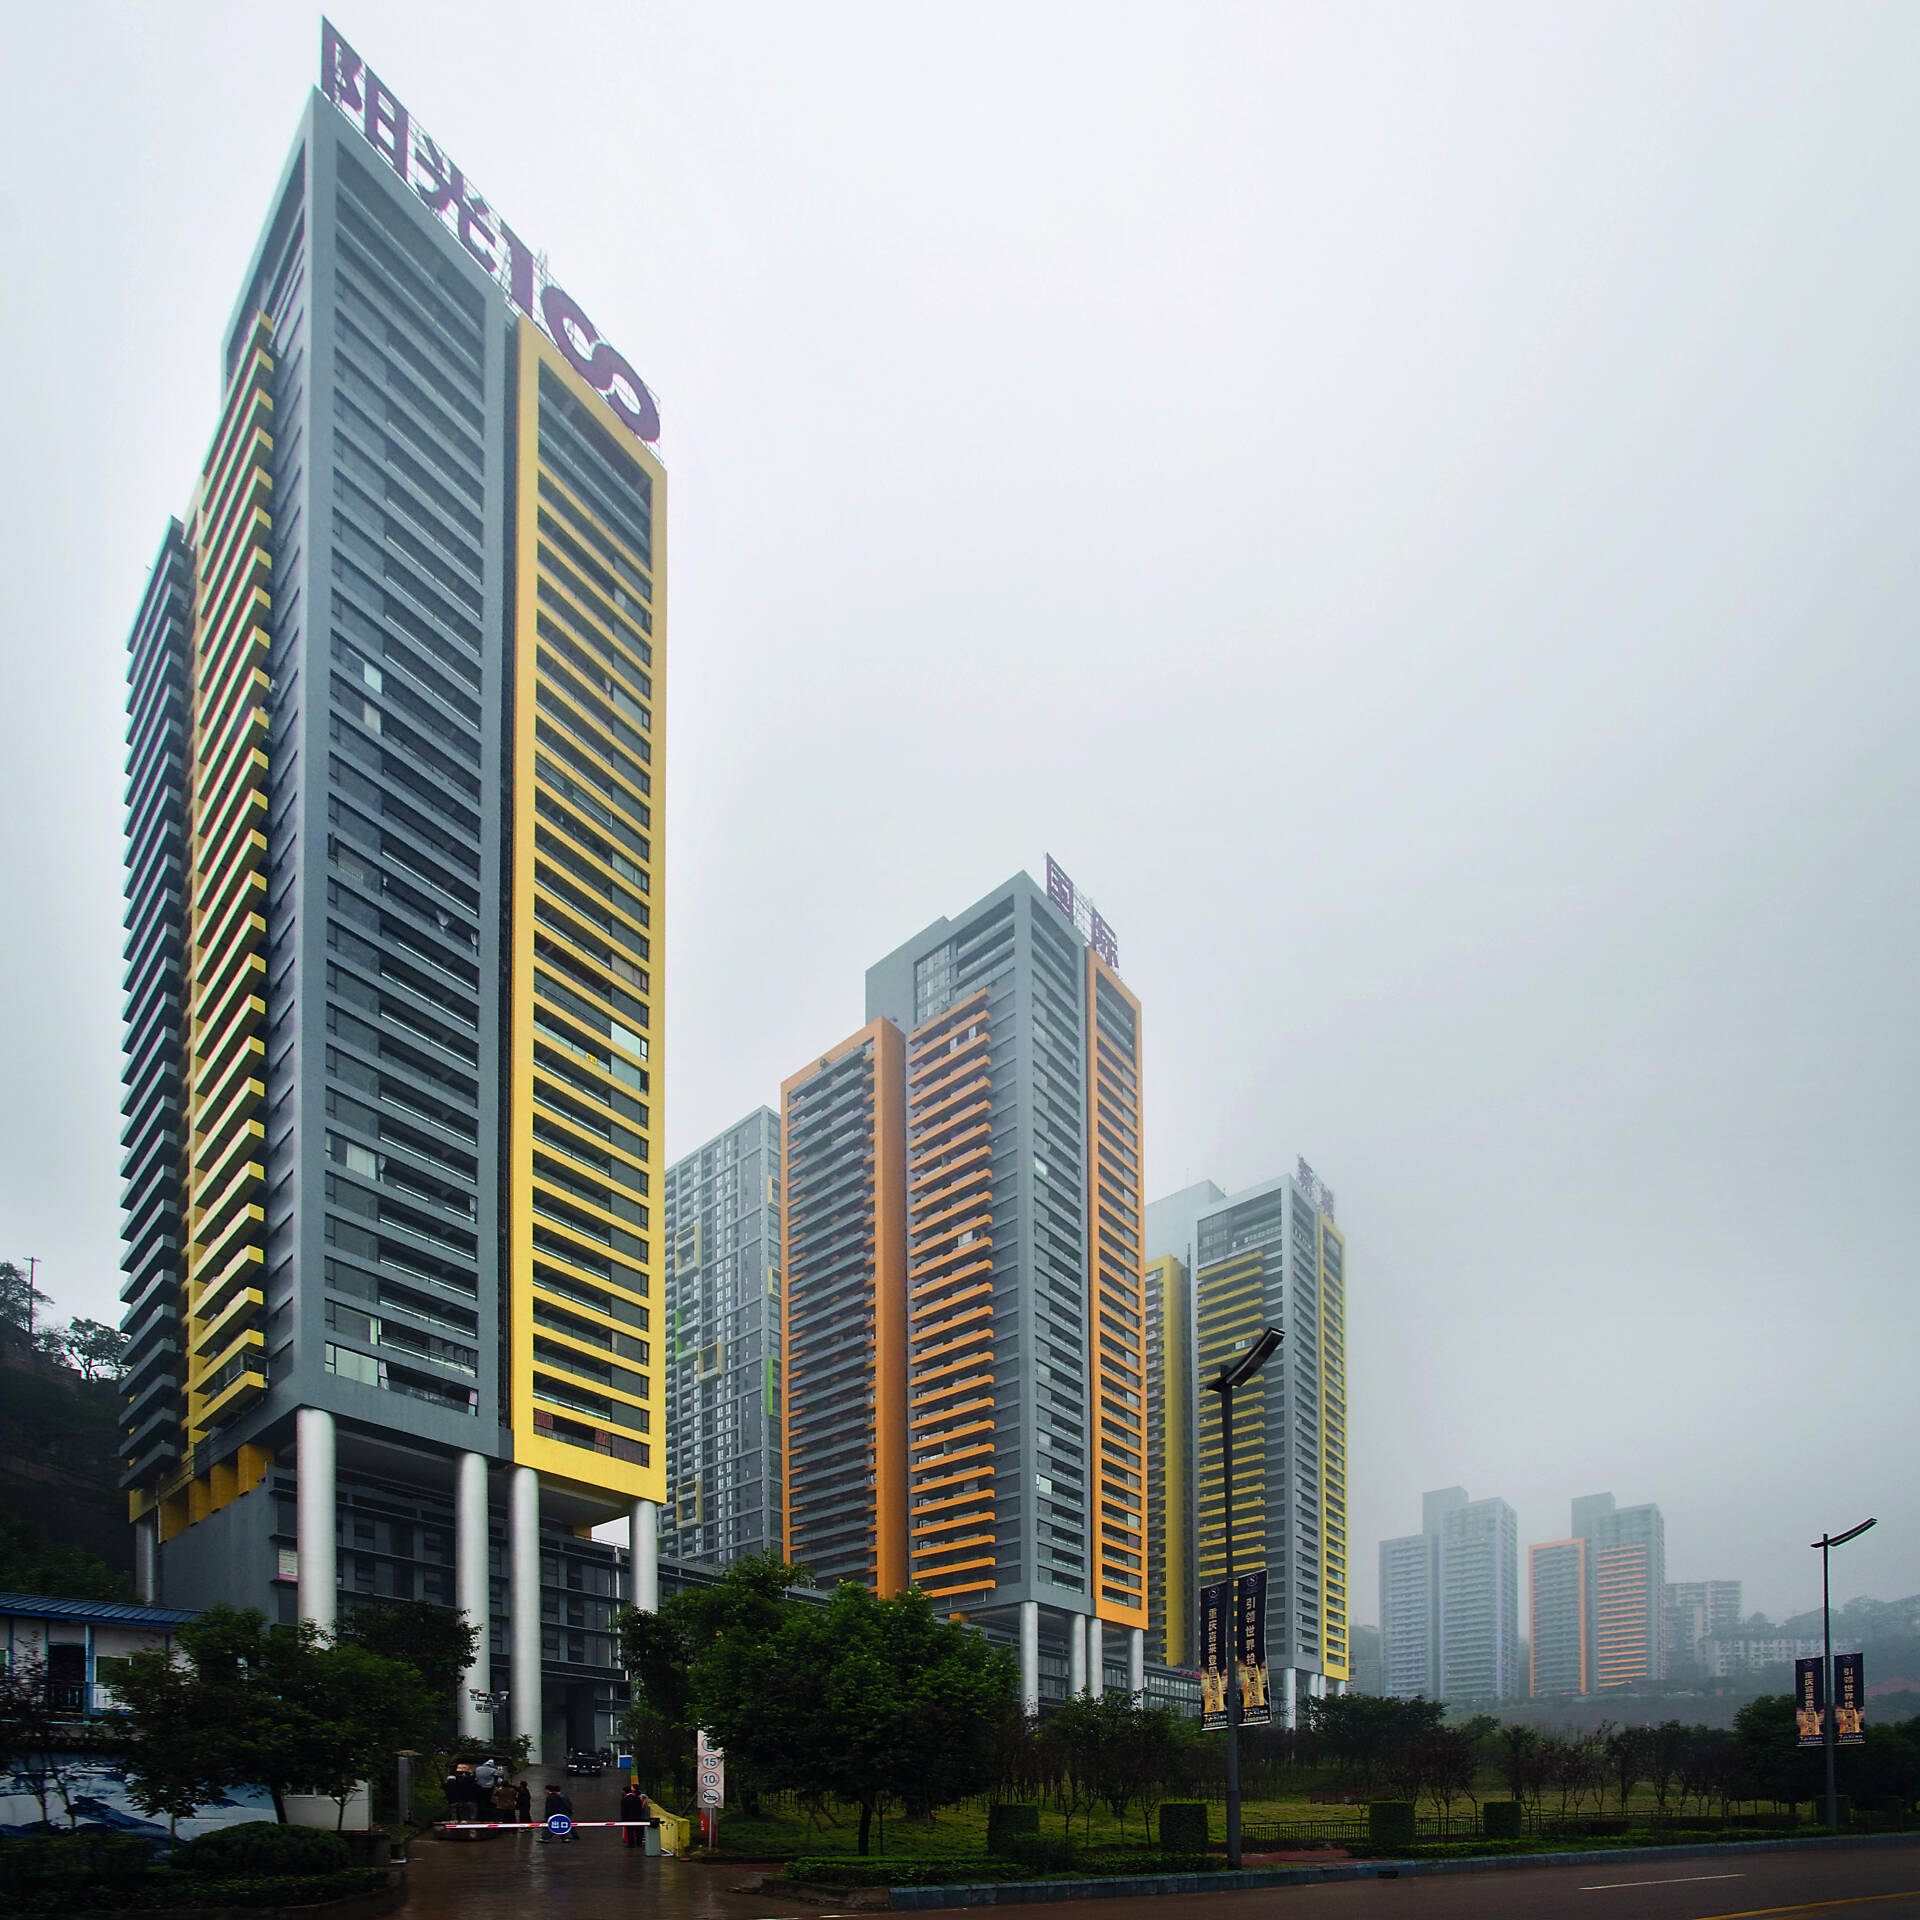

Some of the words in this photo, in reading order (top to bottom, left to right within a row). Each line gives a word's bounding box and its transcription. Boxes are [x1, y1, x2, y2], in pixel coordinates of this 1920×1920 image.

[1046, 852, 1119, 968] 国际
[704, 1757, 718, 1767] 15
[551, 1820, 569, 1829] 出口
